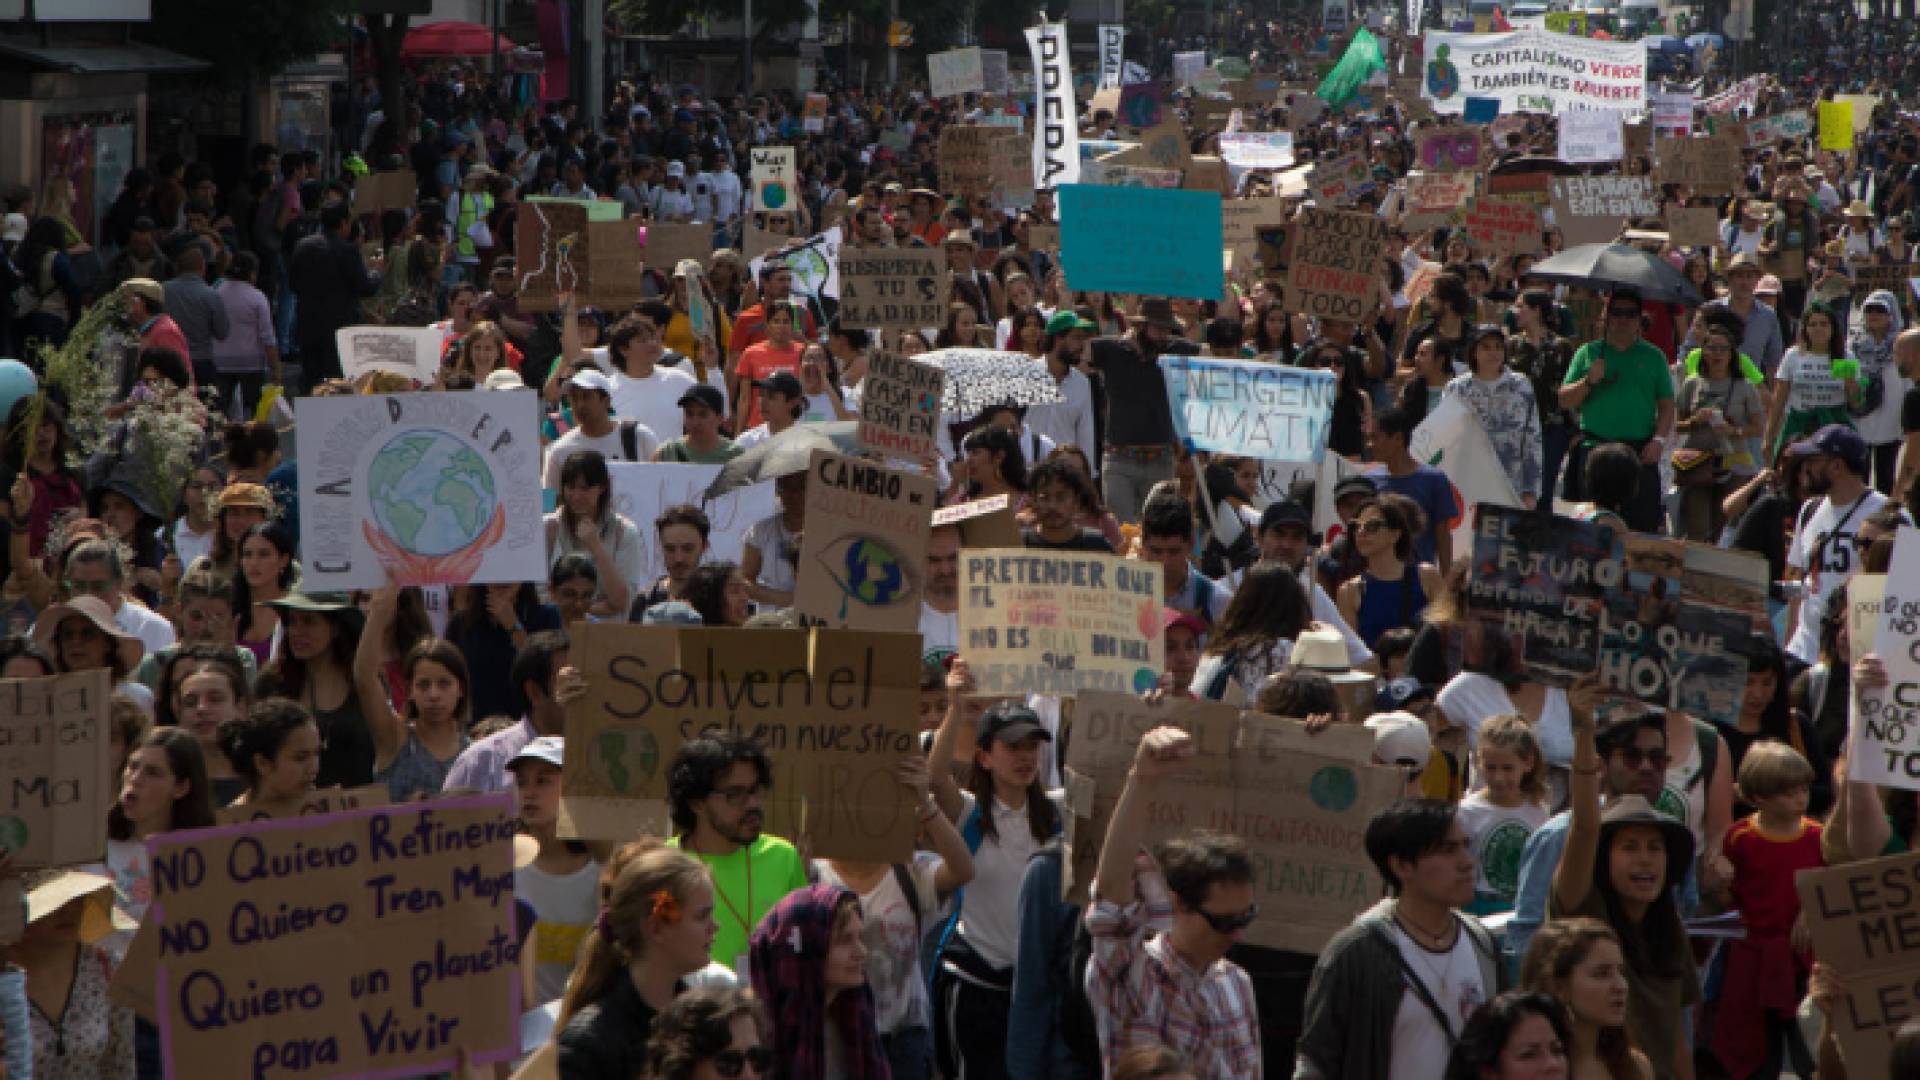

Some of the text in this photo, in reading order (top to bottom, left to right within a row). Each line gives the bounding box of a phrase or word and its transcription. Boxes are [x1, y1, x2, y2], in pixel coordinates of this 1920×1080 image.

[1471, 49, 1643, 79] CAPITALISMO VERDE
[1472, 67, 1642, 101] TAMBIÉN ES MUERTE
[839, 259, 938, 276] RESPETA
[843, 280, 905, 297] A TU
[1299, 289, 1361, 318] TODO
[842, 304, 942, 323] MADRE!
[866, 378, 911, 409] CASA
[910, 416, 933, 437] EN
[820, 458, 901, 500] CAMBIO
[1482, 515, 1516, 542] EL
[969, 557, 1154, 594] PRETENDER QUE
[1499, 545, 1622, 588] FUTURO
[969, 626, 997, 648] NO
[1007, 626, 1029, 648] ES
[1657, 624, 1725, 672] QUE
[603, 646, 874, 719] Salven el
[1602, 651, 1686, 709] HOY
[1865, 720, 1905, 743] NO
[153, 847, 207, 898] NO
[226, 835, 359, 884] Quiero
[158, 863, 514, 959] NO Quiero Tren Maya
[179, 924, 522, 1031] Quiero un planeta
[252, 1005, 461, 1080] para Vivir
